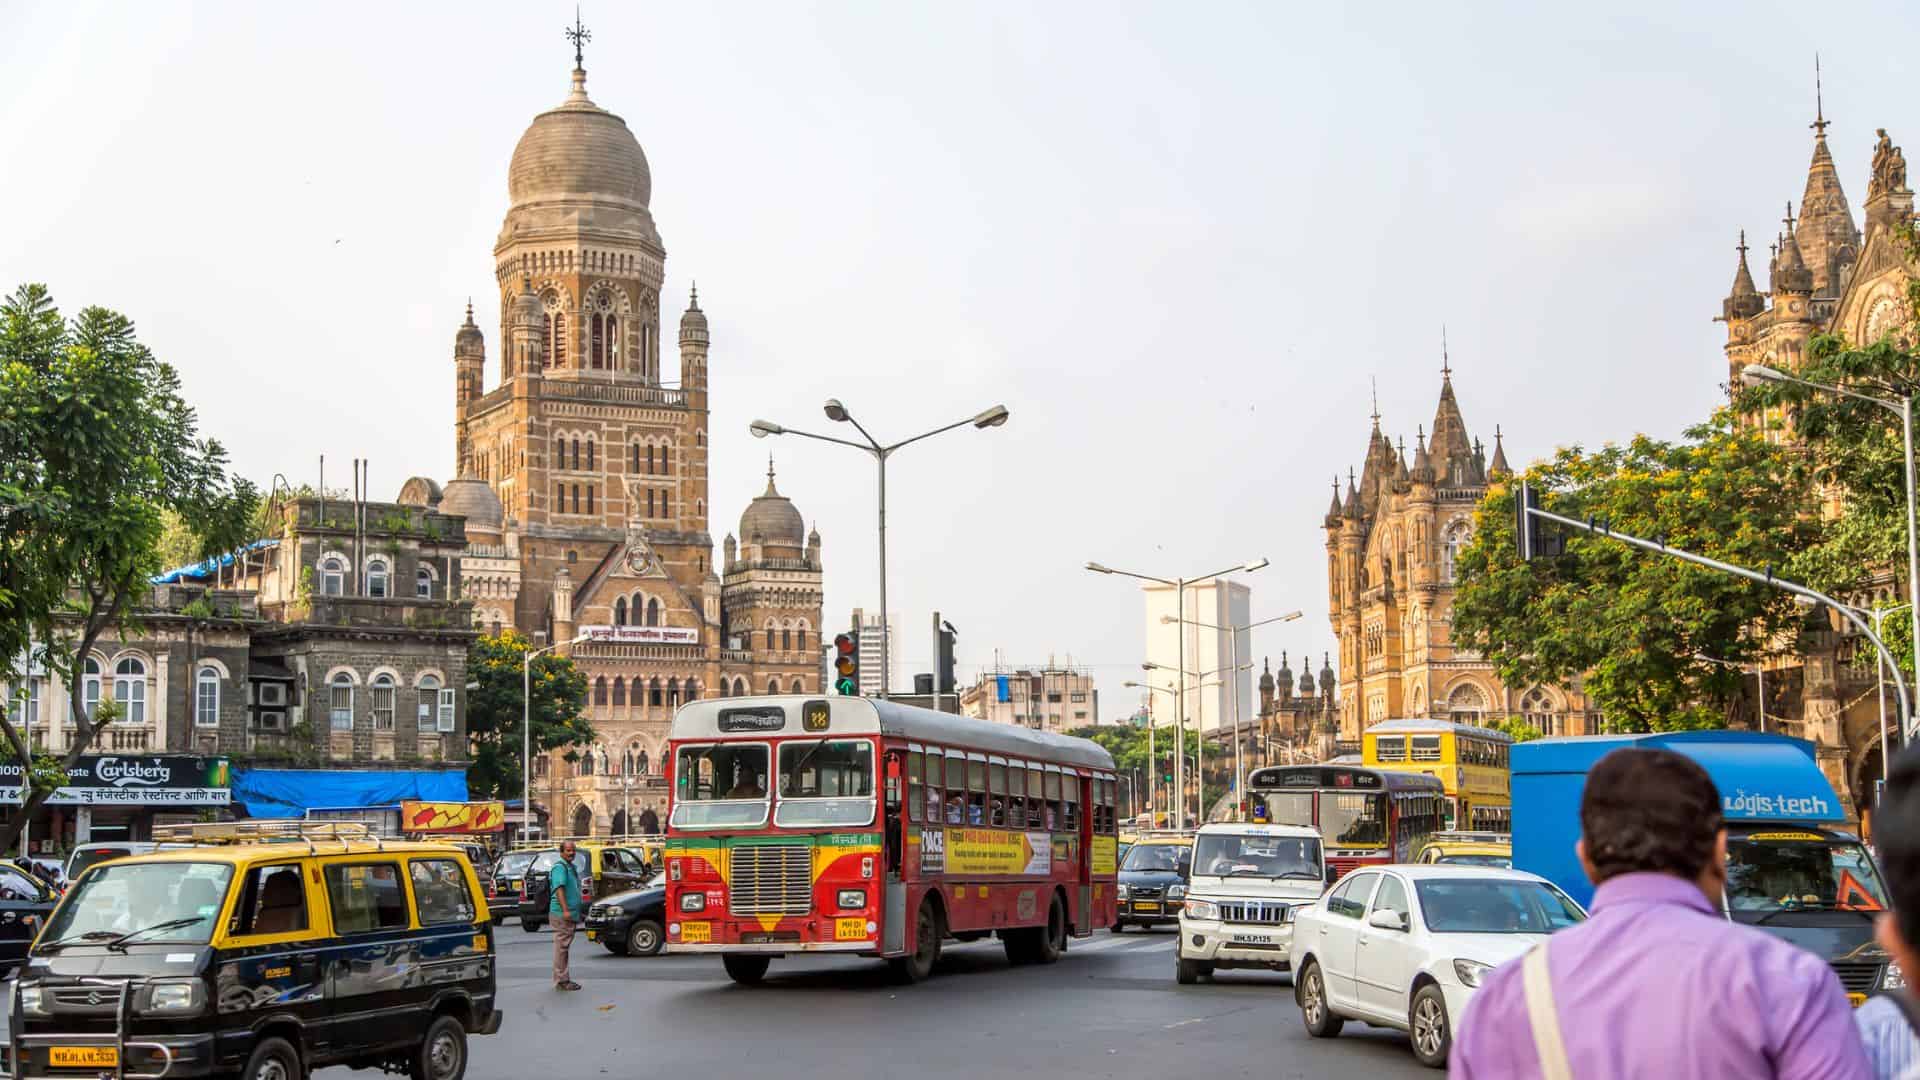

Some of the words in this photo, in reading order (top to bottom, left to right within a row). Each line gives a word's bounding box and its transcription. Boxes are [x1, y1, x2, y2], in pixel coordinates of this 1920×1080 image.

[66, 768, 89, 777] aste
[95, 757, 171, 784] Carlsberg
[184, 789, 208, 800] आणि
